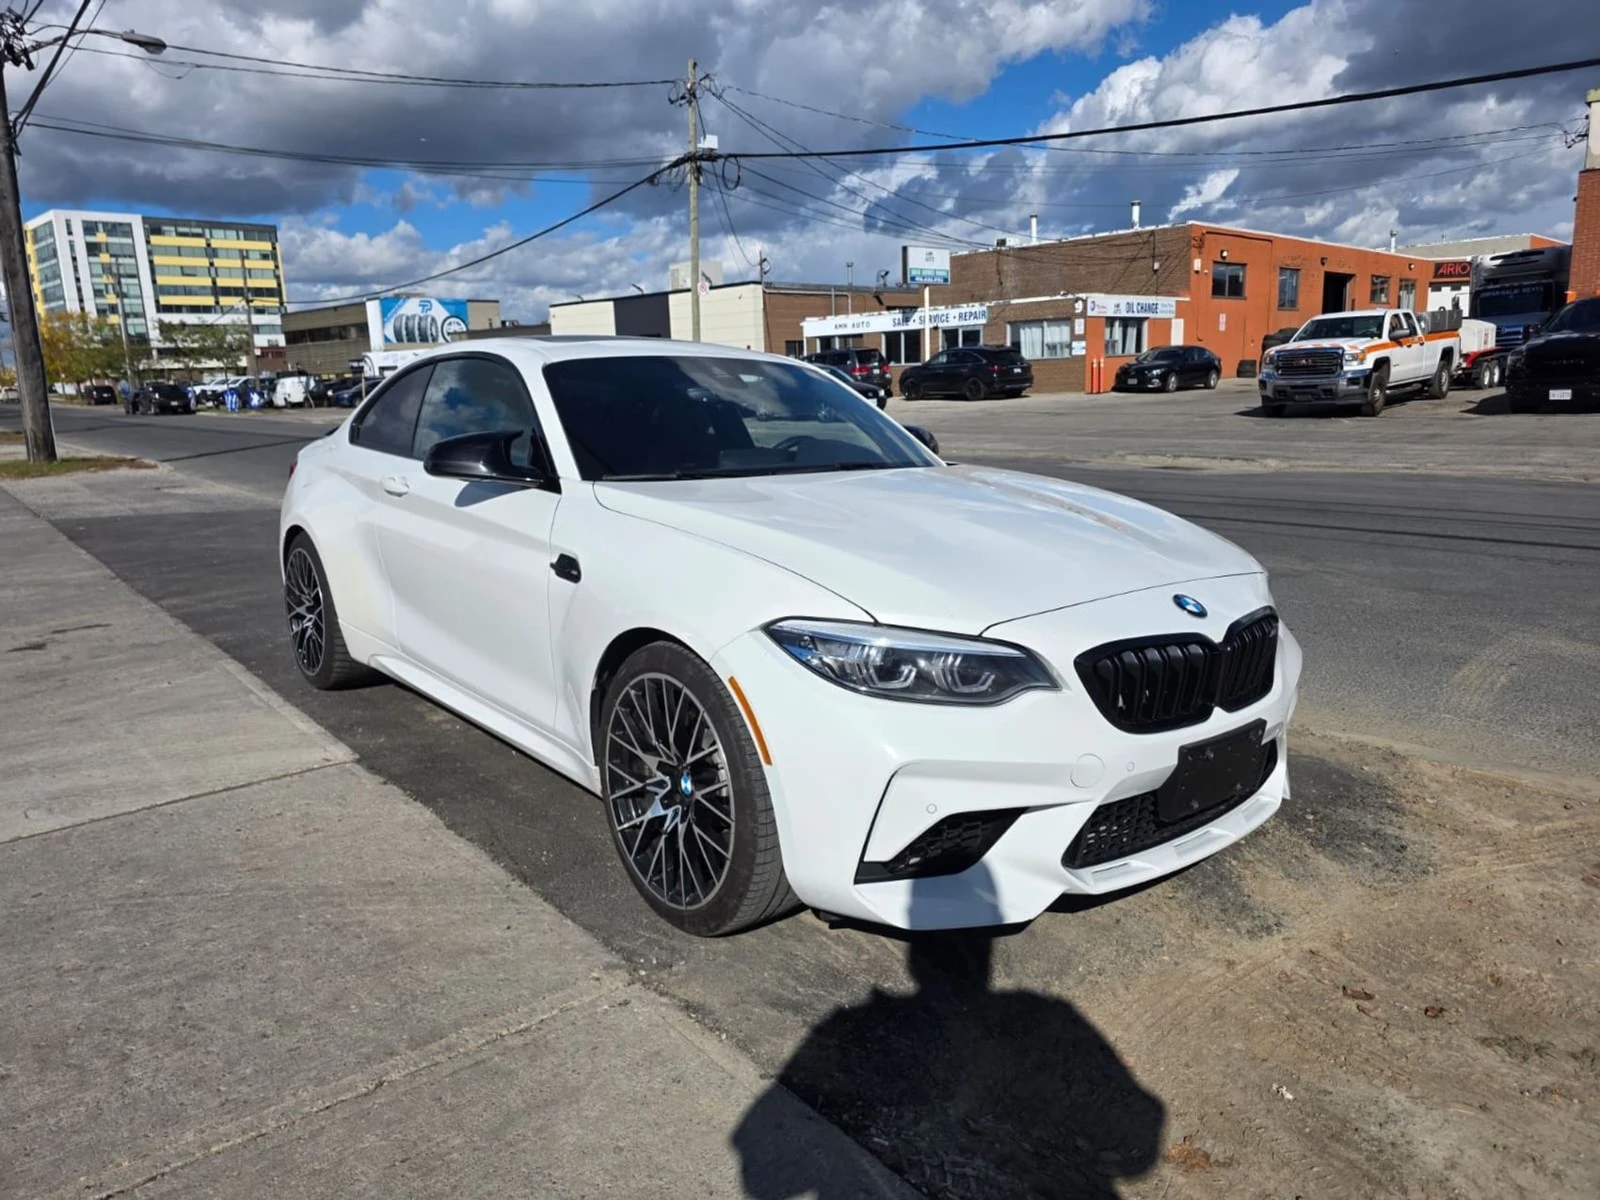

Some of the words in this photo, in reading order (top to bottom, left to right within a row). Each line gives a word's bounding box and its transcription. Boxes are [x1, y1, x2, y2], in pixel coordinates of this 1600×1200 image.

[1125, 302, 1135, 314] OIL
[1136, 302, 1159, 314] CHANGE
[958, 310, 987, 322] REPAIR
[851, 320, 871, 329] AUTO
